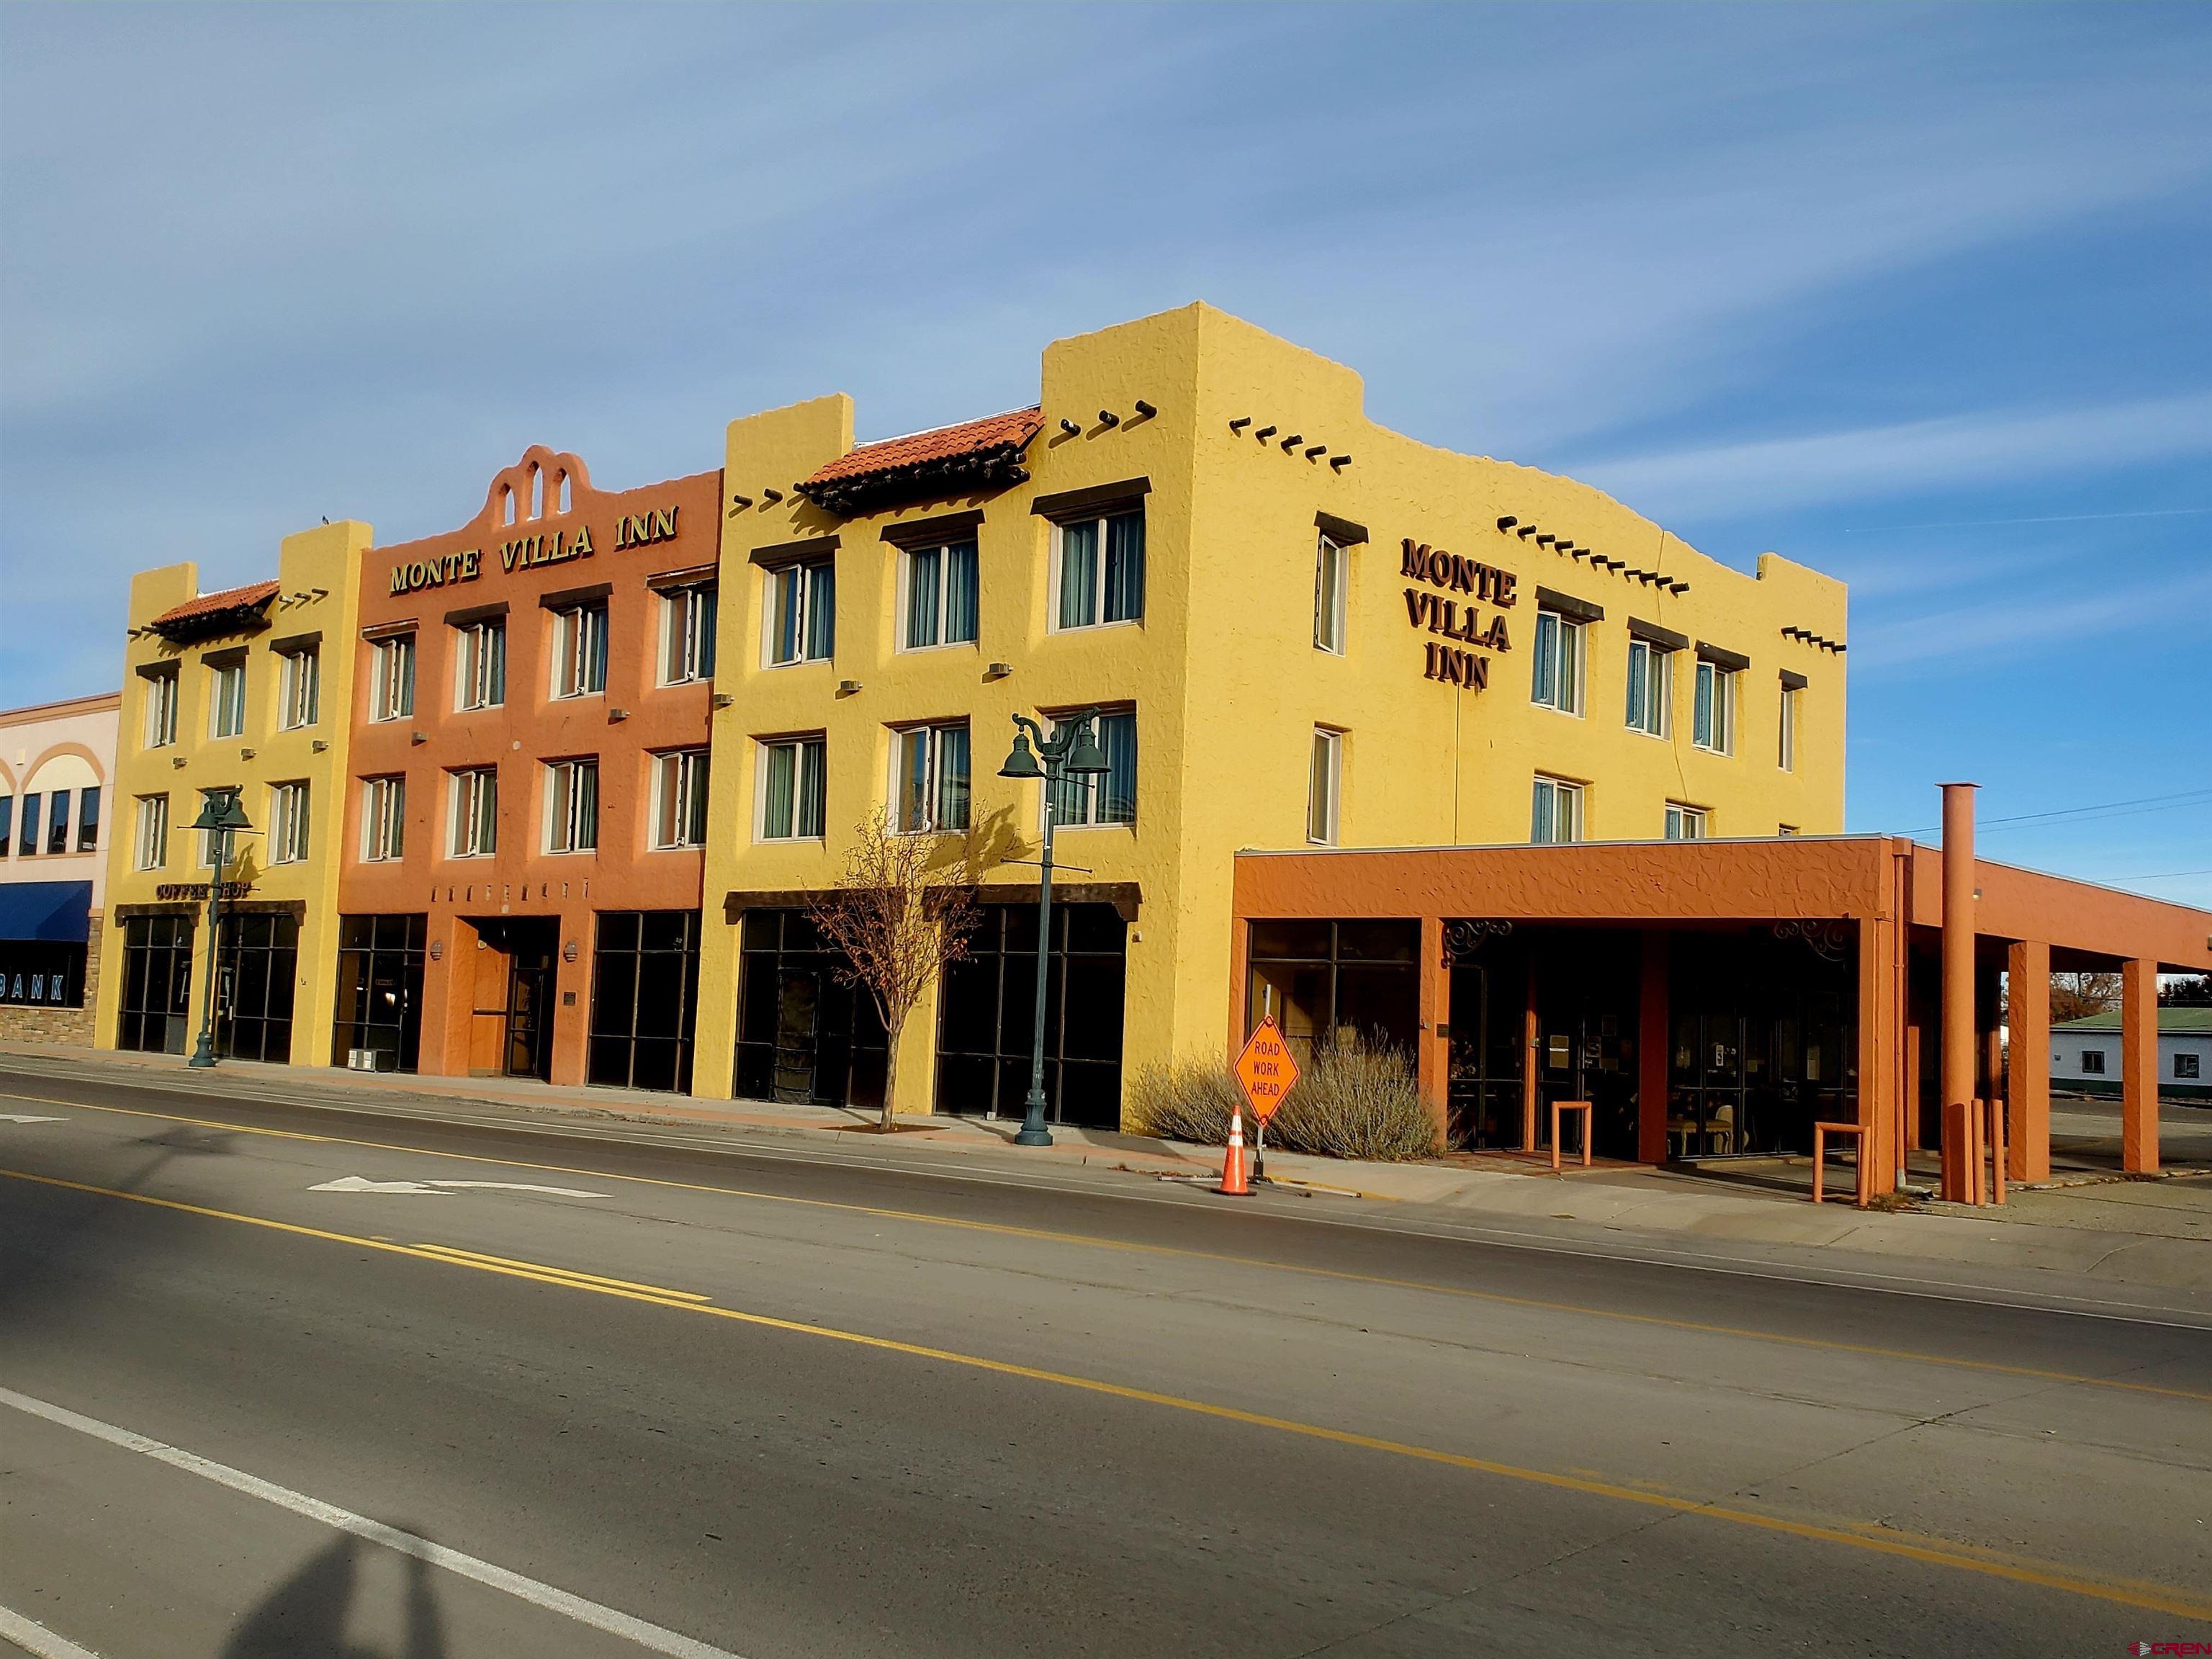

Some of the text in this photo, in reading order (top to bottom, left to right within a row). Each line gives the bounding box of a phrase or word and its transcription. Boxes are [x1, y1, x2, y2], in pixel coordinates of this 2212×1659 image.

[390, 505, 678, 595] MONTE VILLA INN
[1400, 538, 1517, 610] MONTE
[1403, 588, 1512, 653] VILLA
[1423, 642, 1491, 690] INN
[156, 881, 252, 900] COFFEE HOP
[1254, 1040, 1280, 1056] ROAD
[1253, 1060, 1280, 1077] WORK
[1251, 1081, 1280, 1097] AHEAD
